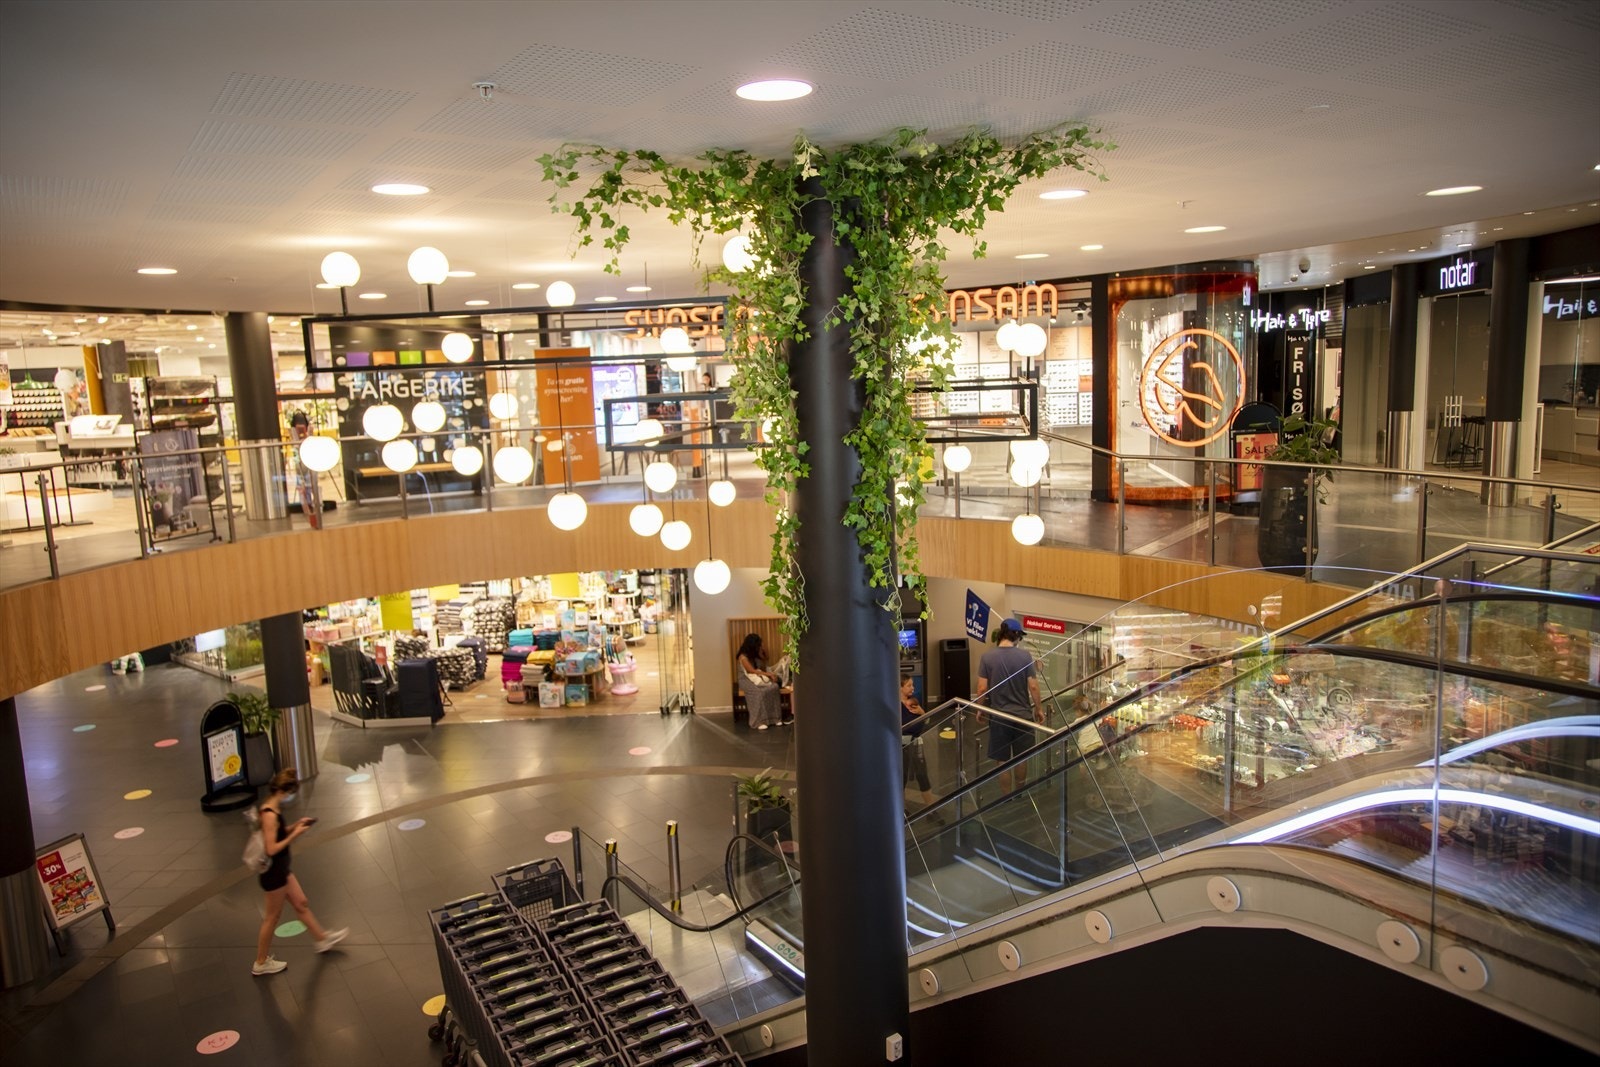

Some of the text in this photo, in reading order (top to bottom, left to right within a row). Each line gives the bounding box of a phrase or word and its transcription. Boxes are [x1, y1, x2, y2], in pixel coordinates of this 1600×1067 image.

[1440, 257, 1476, 290] notar
[908, 283, 1058, 323] NSAM
[1257, 309, 1286, 333] Hair
[348, 377, 476, 400] FARGERIKE
[1291, 347, 1304, 416] FRISØ
